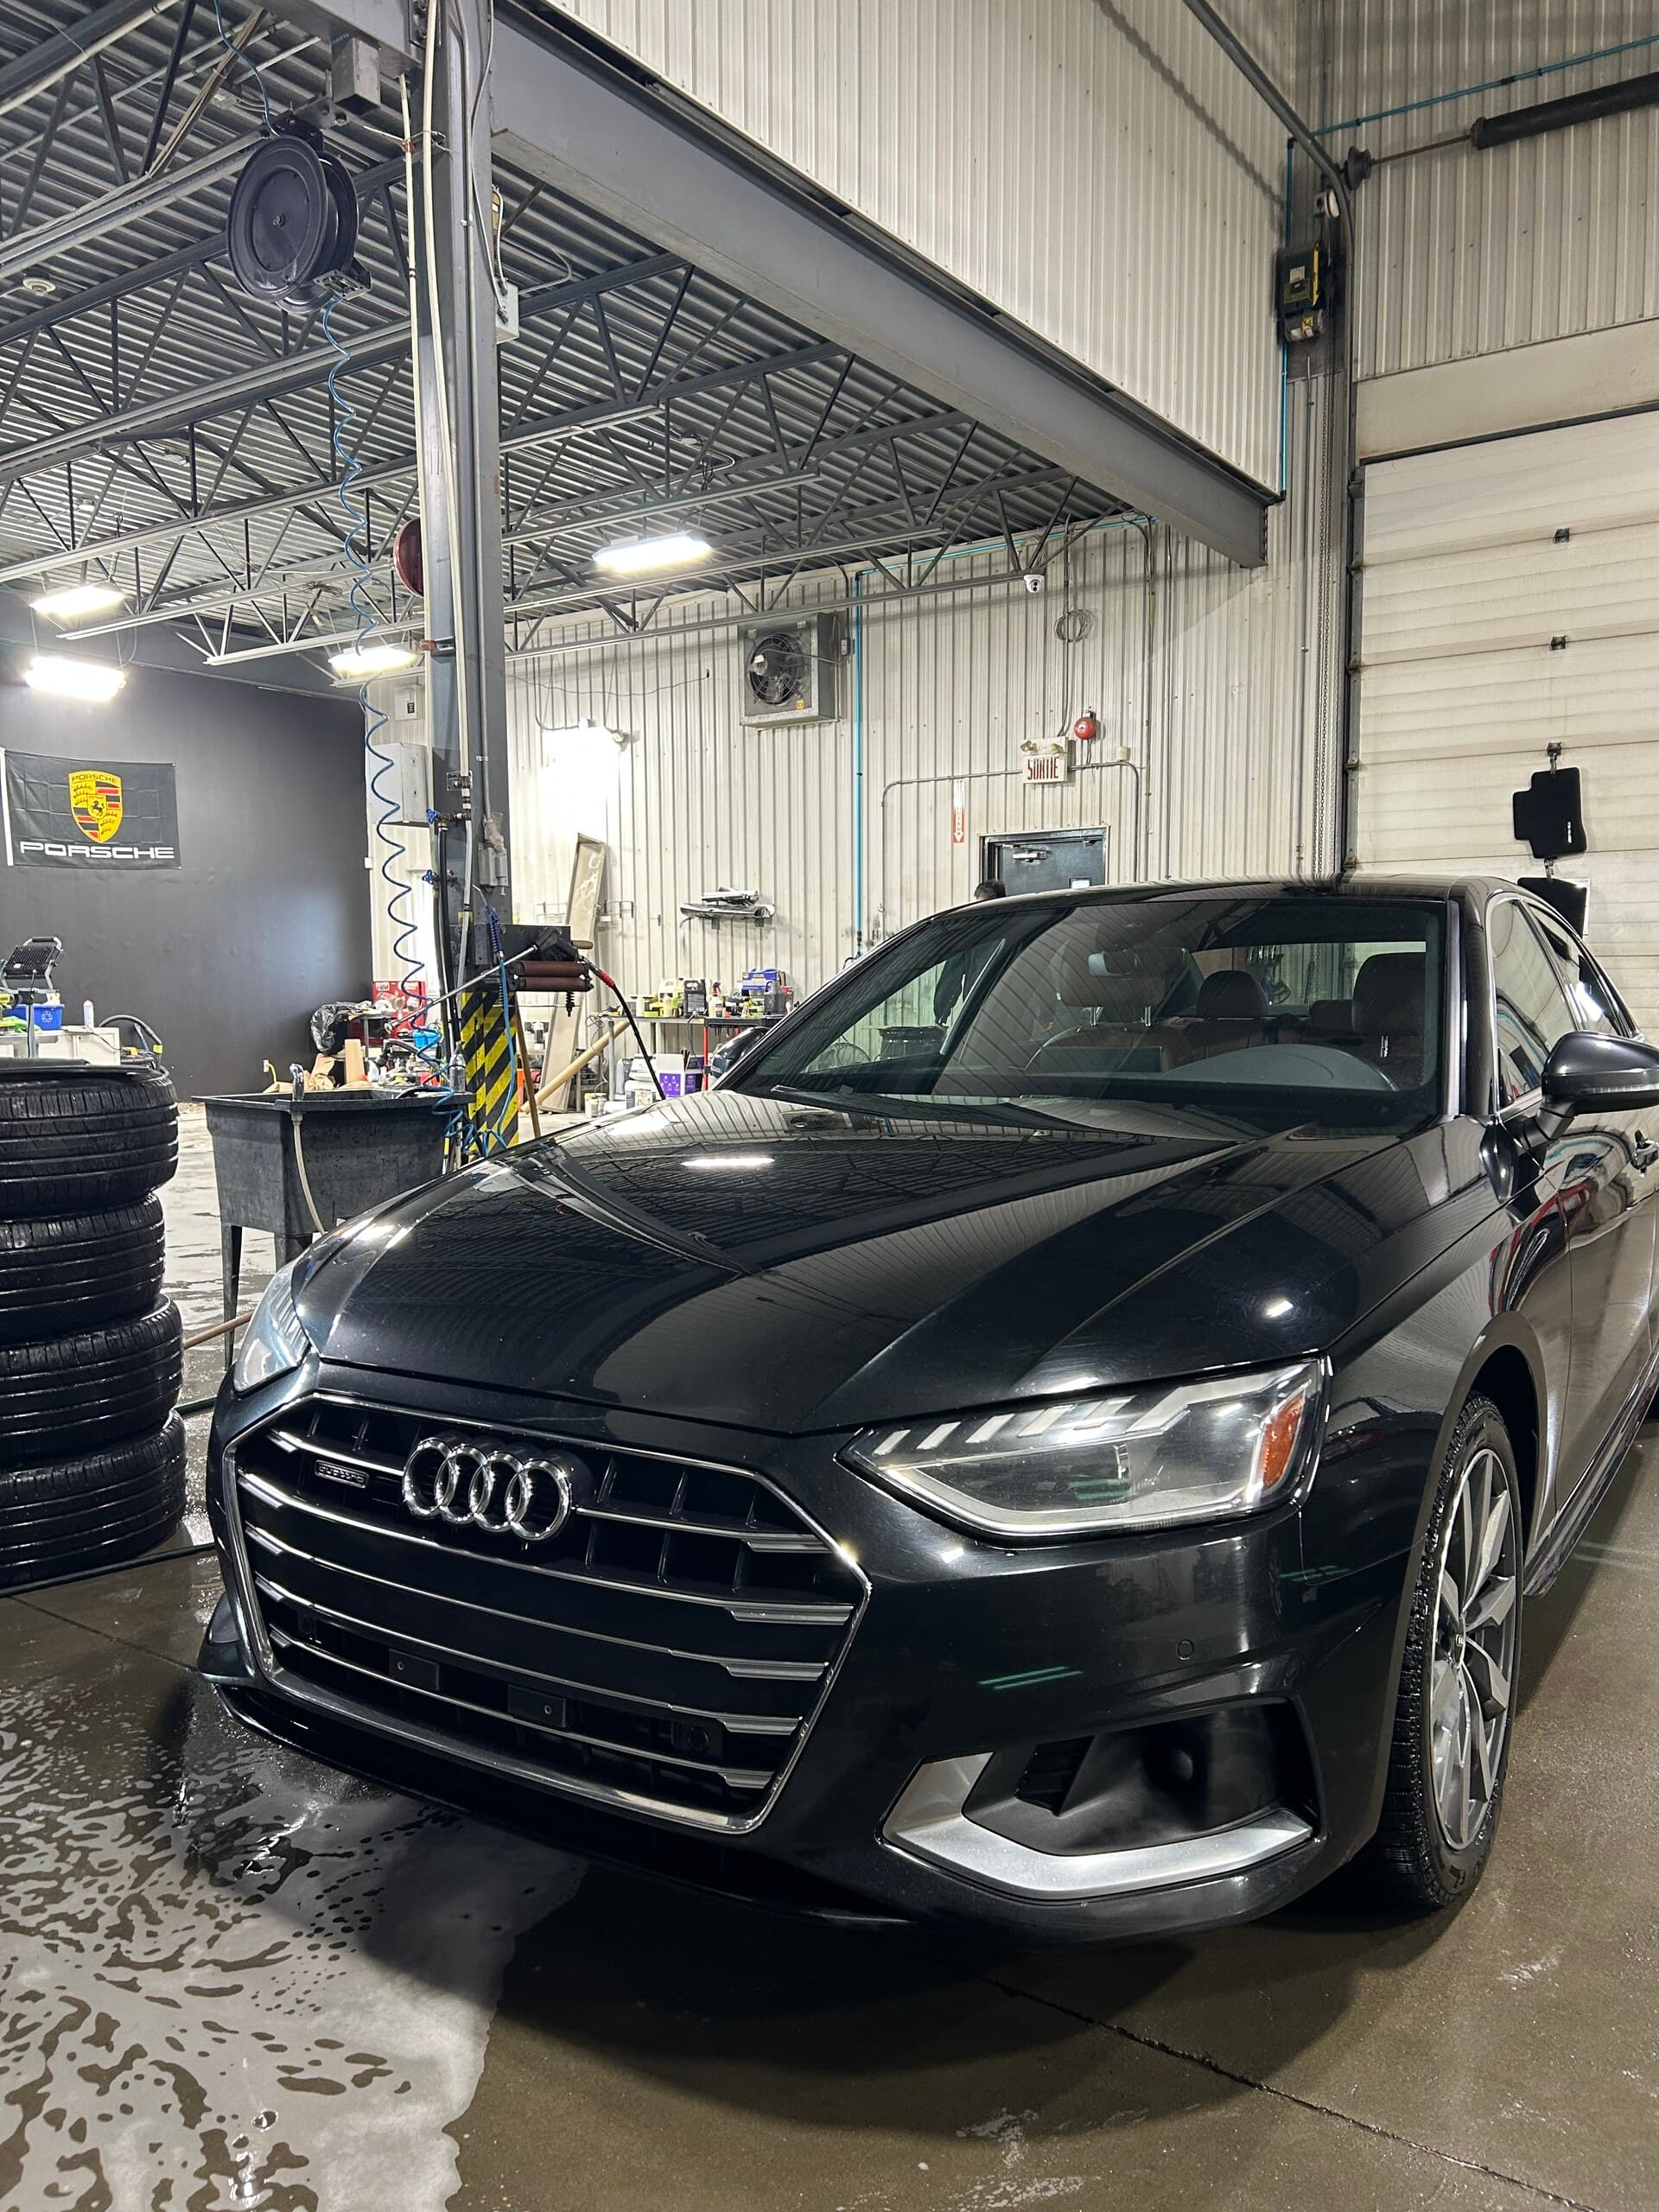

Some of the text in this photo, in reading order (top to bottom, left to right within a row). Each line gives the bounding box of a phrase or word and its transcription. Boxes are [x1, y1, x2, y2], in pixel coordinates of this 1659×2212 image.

[1027, 756, 1059, 780] SORTIE
[72, 773, 118, 784] PORSCHE
[20, 841, 175, 859] PORSCHE
